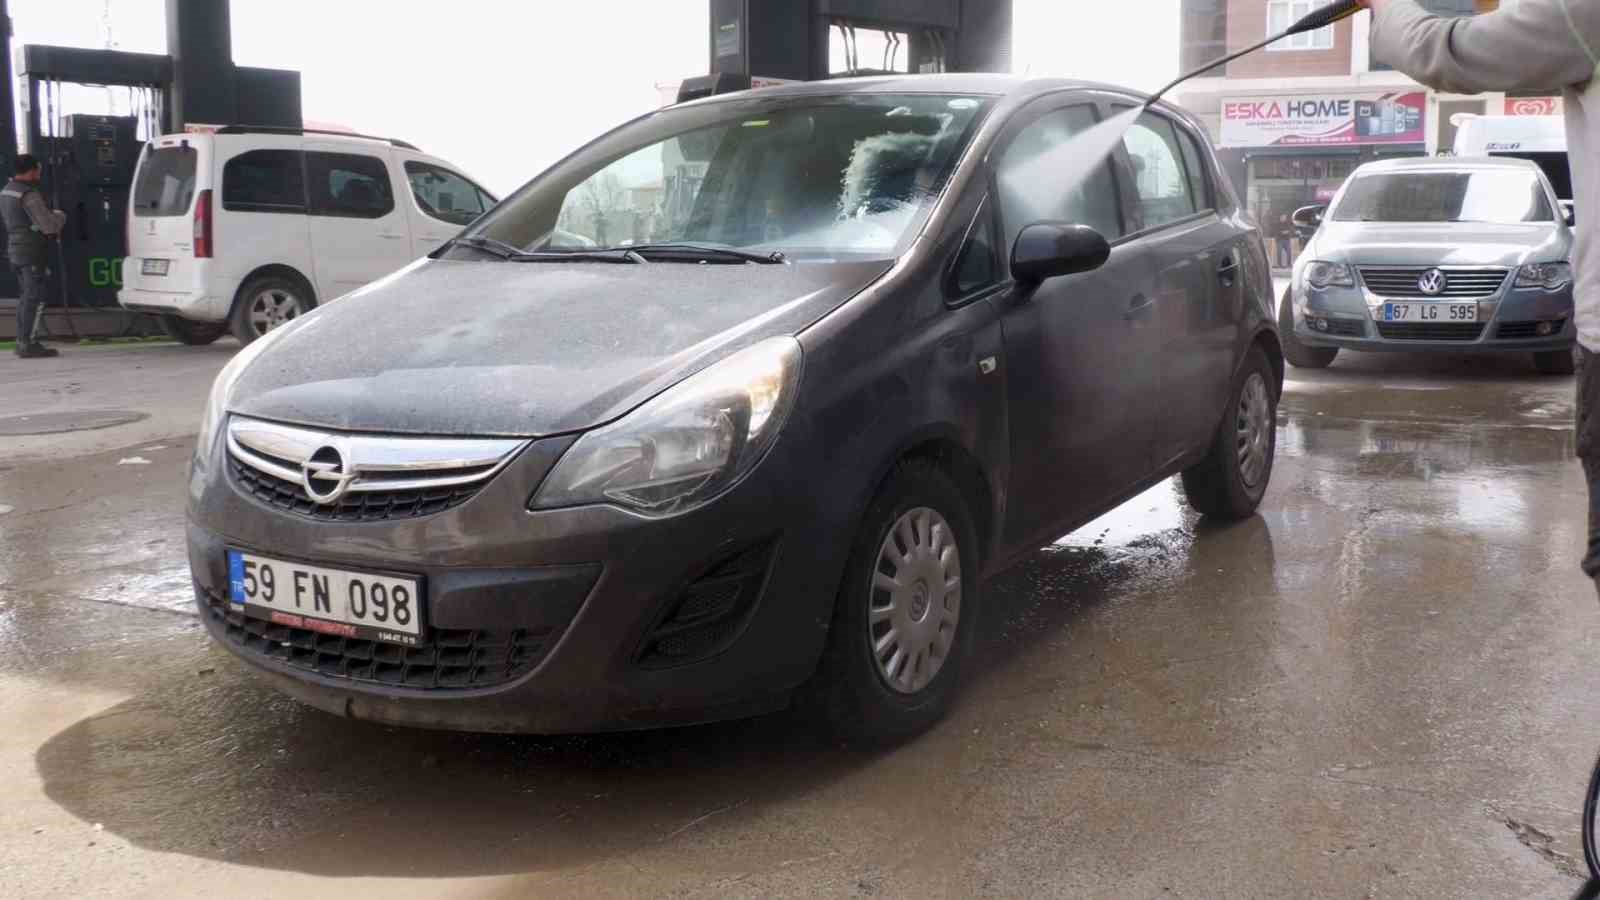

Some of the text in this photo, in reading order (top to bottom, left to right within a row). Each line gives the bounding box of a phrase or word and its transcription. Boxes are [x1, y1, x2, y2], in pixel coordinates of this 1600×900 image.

[1225, 100, 1350, 120] ESKA HOME
[1393, 305, 1475, 320] 67 LG 595
[244, 560, 276, 602] 59
[293, 570, 331, 614] FN
[349, 579, 412, 626] 098
